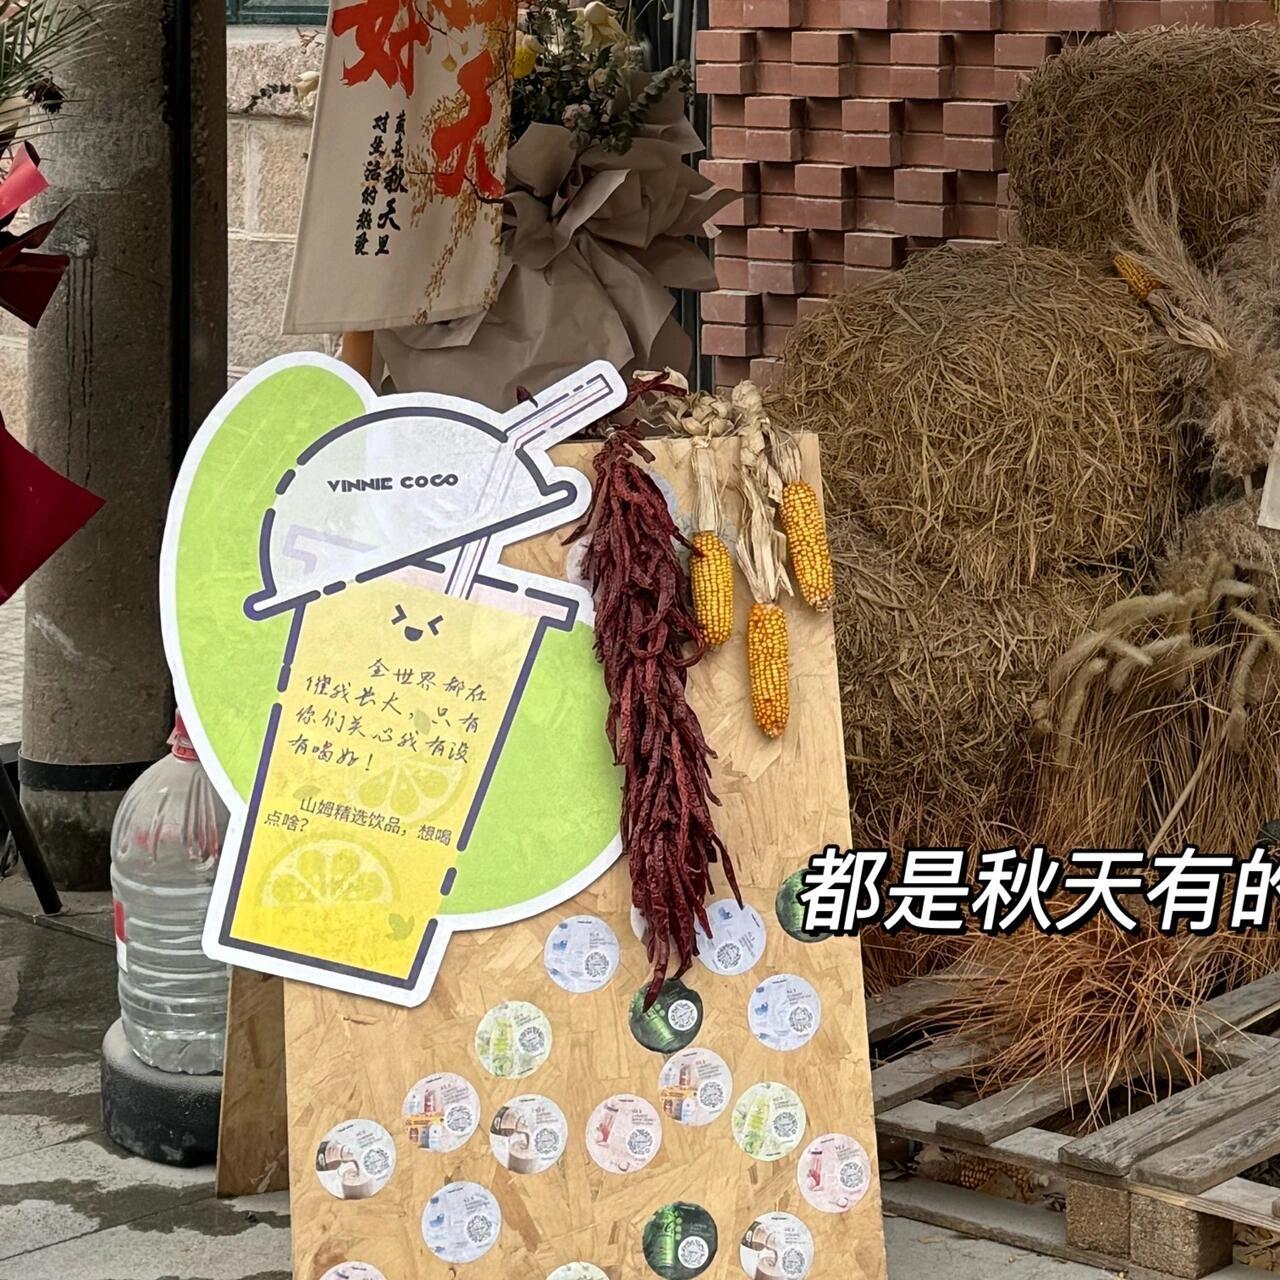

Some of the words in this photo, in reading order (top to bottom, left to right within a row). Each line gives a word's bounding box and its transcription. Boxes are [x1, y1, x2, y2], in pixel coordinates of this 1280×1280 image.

[327, 477, 393, 493] VINNIE
[400, 473, 459, 489] COCO
[367, 657, 488, 703] 全世界都在
[296, 705, 469, 764] 你们关心我有没
